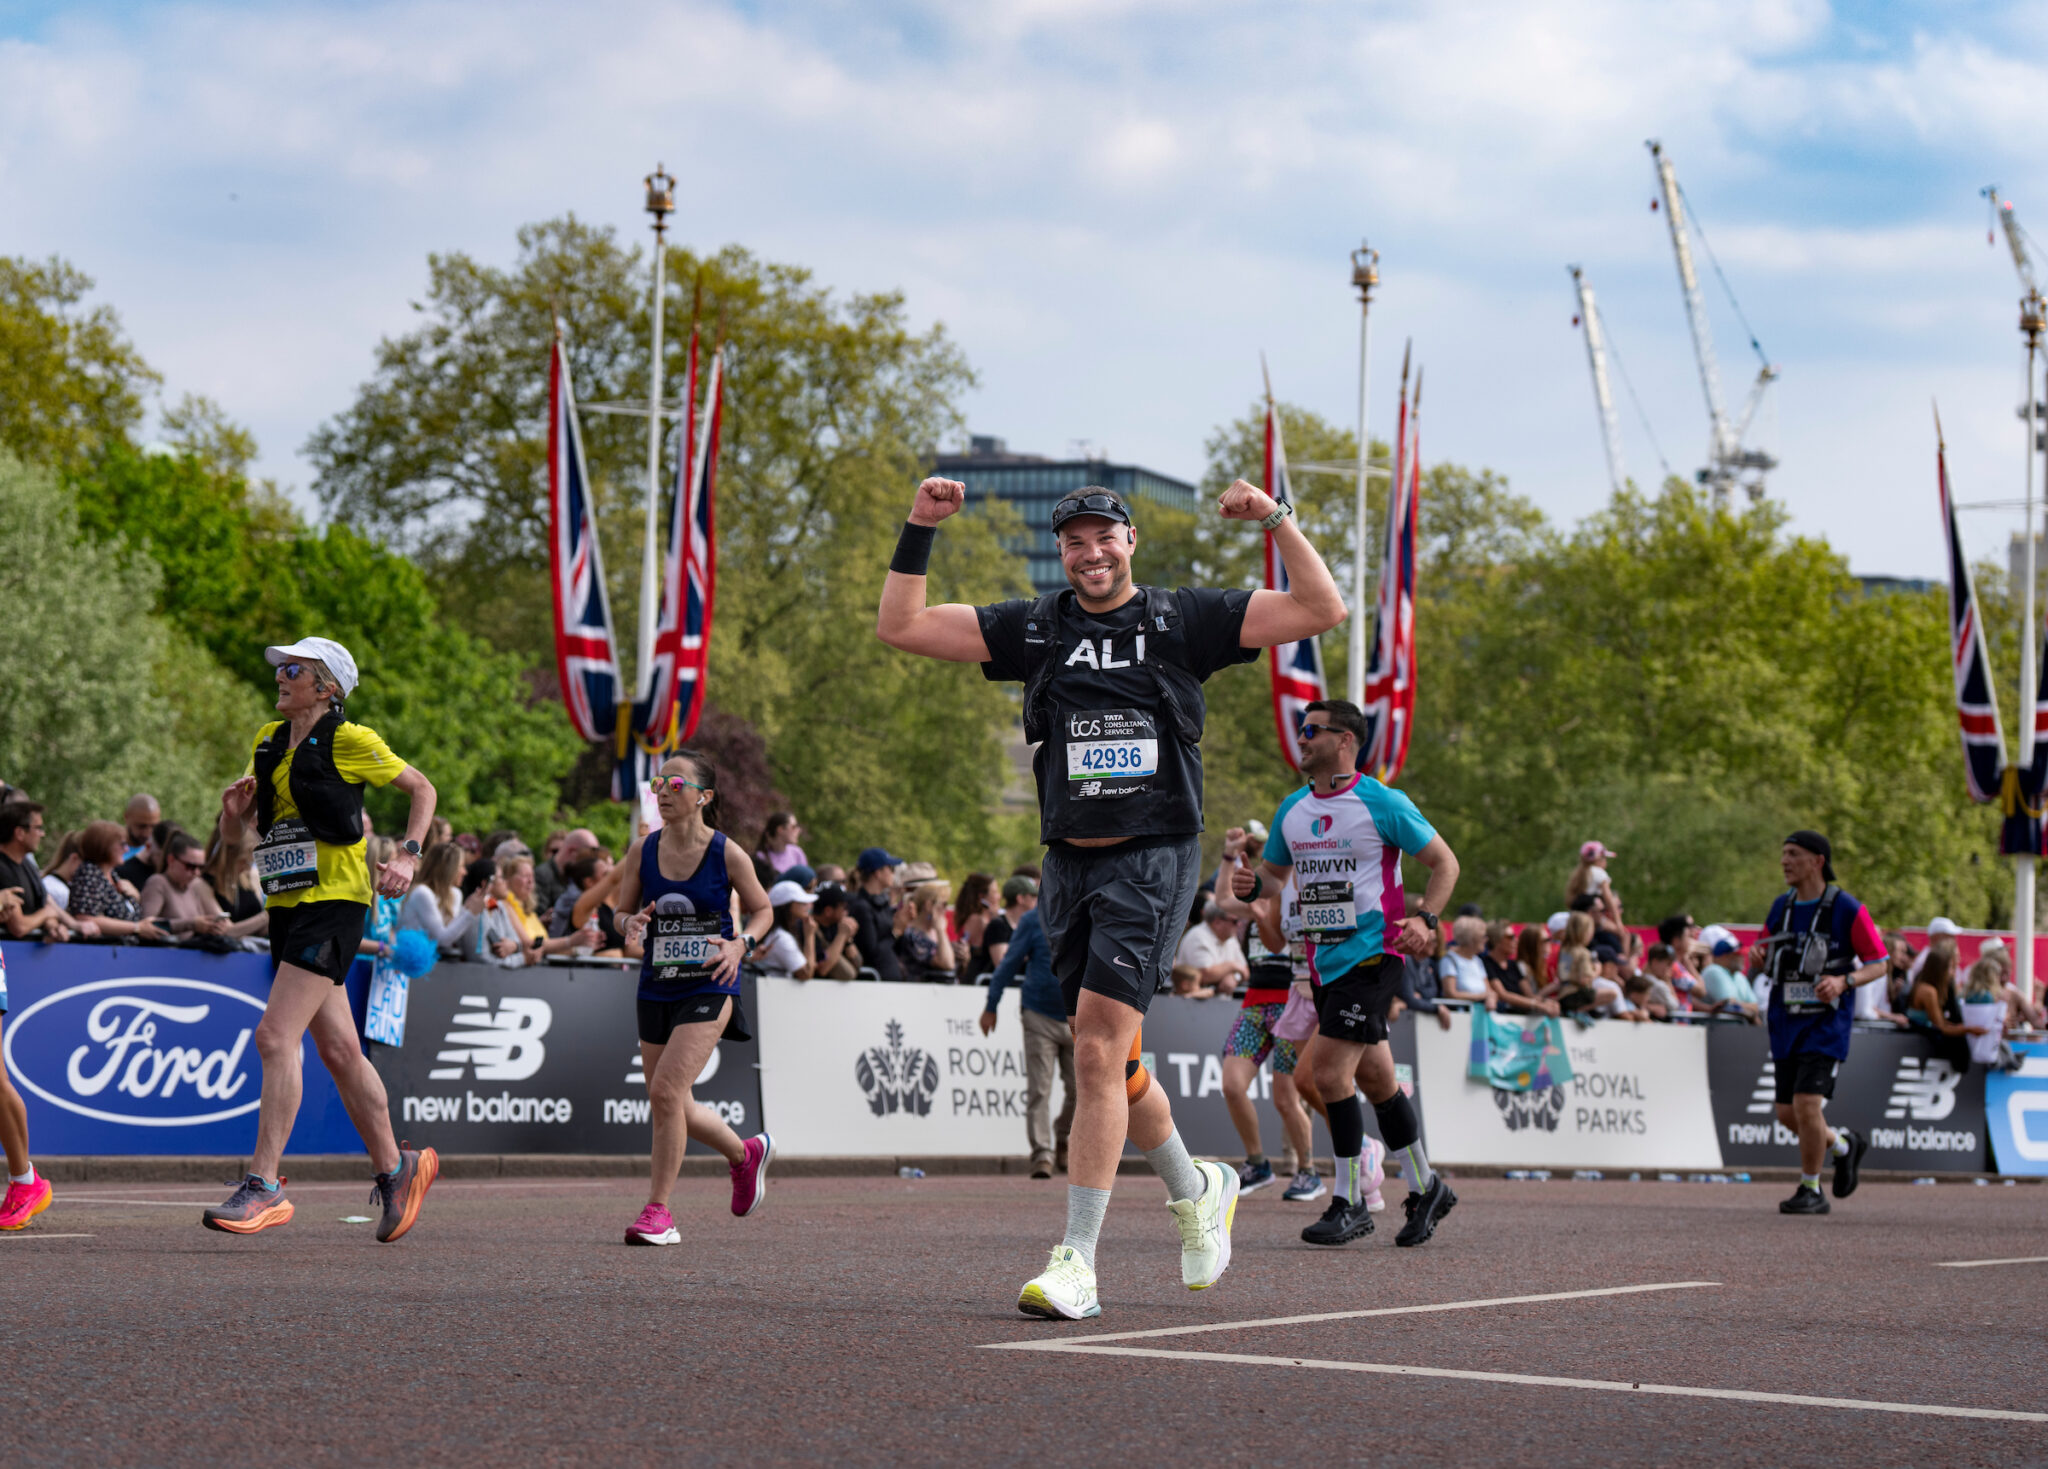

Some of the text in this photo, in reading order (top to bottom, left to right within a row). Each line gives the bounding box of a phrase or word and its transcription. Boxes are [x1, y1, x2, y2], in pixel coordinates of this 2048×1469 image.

[1064, 634, 1146, 670] ALI
[1071, 717, 1101, 737] tcs
[1104, 720, 1150, 728] CONSULTANCY
[1082, 747, 1141, 769] 42936
[264, 849, 305, 872] 58508
[1295, 858, 1357, 875] CARWYN
[287, 880, 313, 889] balance
[657, 918, 680, 933] tcs
[1306, 908, 1345, 925] 65683
[663, 941, 709, 958] 56487
[946, 1018, 976, 1036] THE
[67, 995, 252, 1100] Ford
[1571, 1047, 1597, 1064] THE
[949, 1048, 1028, 1078] ROYAL
[1574, 1073, 1647, 1101] ROYAL
[403, 1091, 572, 1123] new balance
[604, 1099, 651, 1123] new
[1576, 1108, 1648, 1135] PARKS
[1728, 1123, 1772, 1145] new
[1871, 1127, 1901, 1150] new
[1907, 1125, 1977, 1152] balance
